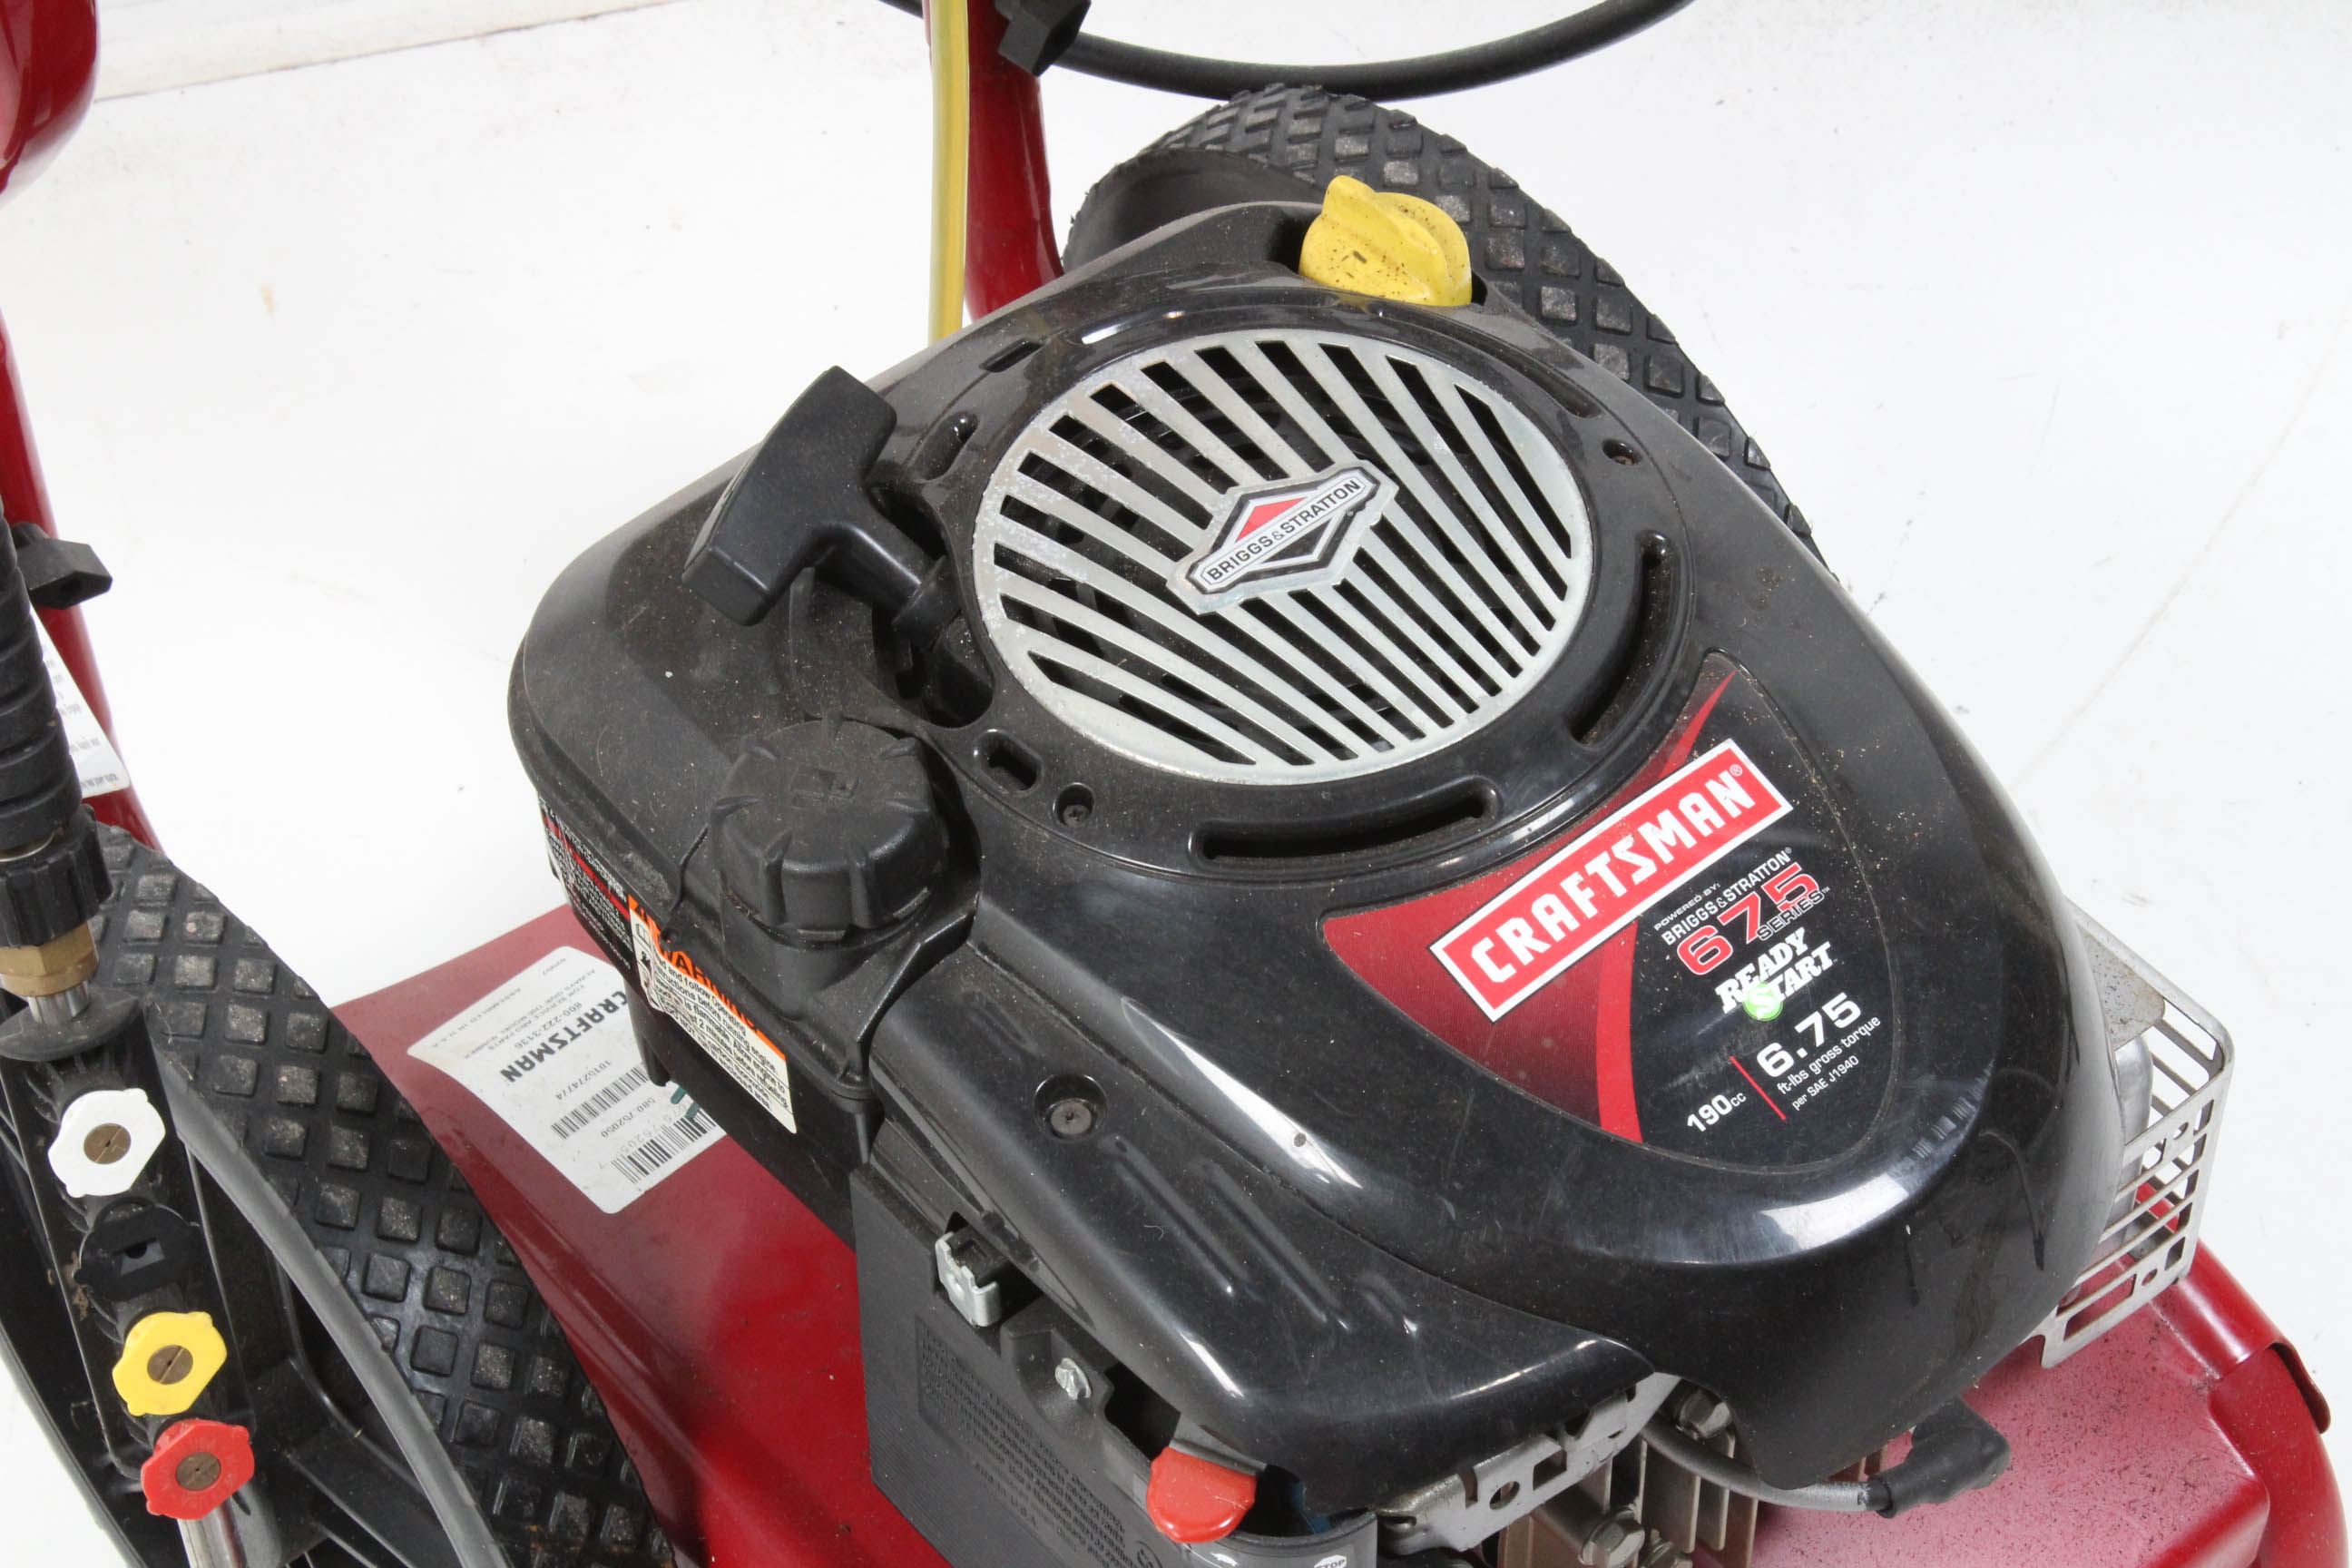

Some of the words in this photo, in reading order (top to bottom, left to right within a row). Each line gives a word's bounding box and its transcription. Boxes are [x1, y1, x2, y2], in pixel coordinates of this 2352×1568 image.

[1471, 769, 1756, 984] CRAFTSMAN
[1653, 894, 1702, 931] POWERED
[1755, 887, 1826, 941] SERIES
[1673, 861, 1822, 976] 675
[1713, 926, 1809, 1014] READY
[1749, 940, 1835, 1020] START
[499, 989, 629, 1082] CRAFTSMAN
[1756, 992, 1862, 1079] 6.75
[1776, 1066, 1809, 1094] ft-lbs
[1808, 1044, 1842, 1074] gross
[1840, 1015, 1881, 1047] torque
[1791, 1093, 1808, 1110] per
[1807, 1077, 1828, 1096] SAE
[1826, 1054, 1859, 1083] J1940
